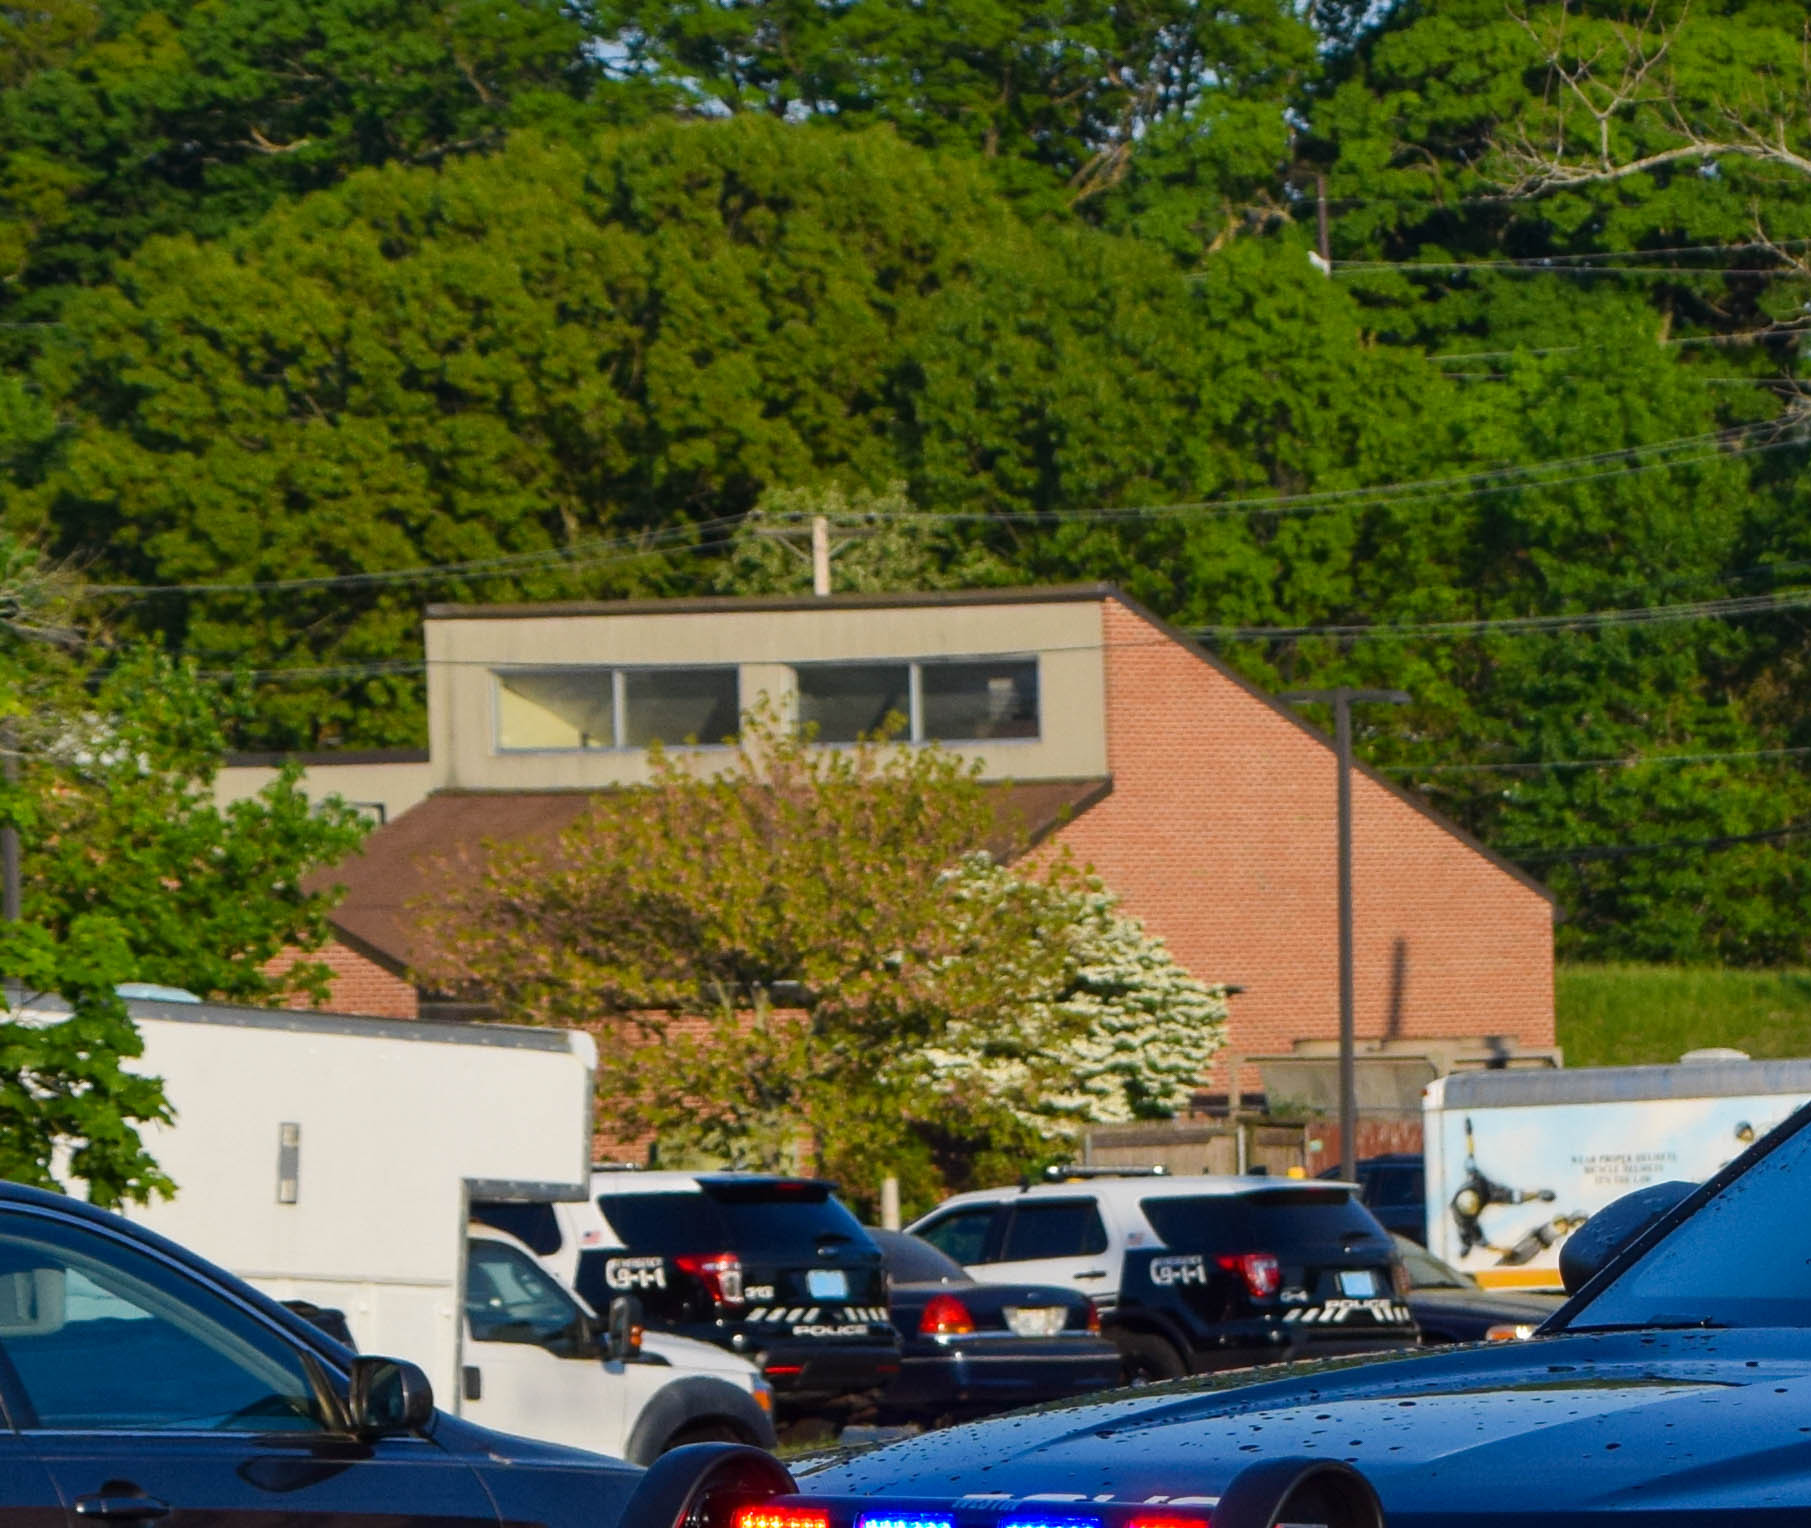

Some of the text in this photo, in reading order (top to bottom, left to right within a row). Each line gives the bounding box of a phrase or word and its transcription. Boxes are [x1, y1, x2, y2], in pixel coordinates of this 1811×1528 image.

[617, 1267, 667, 1289] 9-1-1
[1159, 1265, 1207, 1285] 9-1-1
[1325, 1299, 1392, 1311] POLICE
[792, 1323, 869, 1337] POLICE
